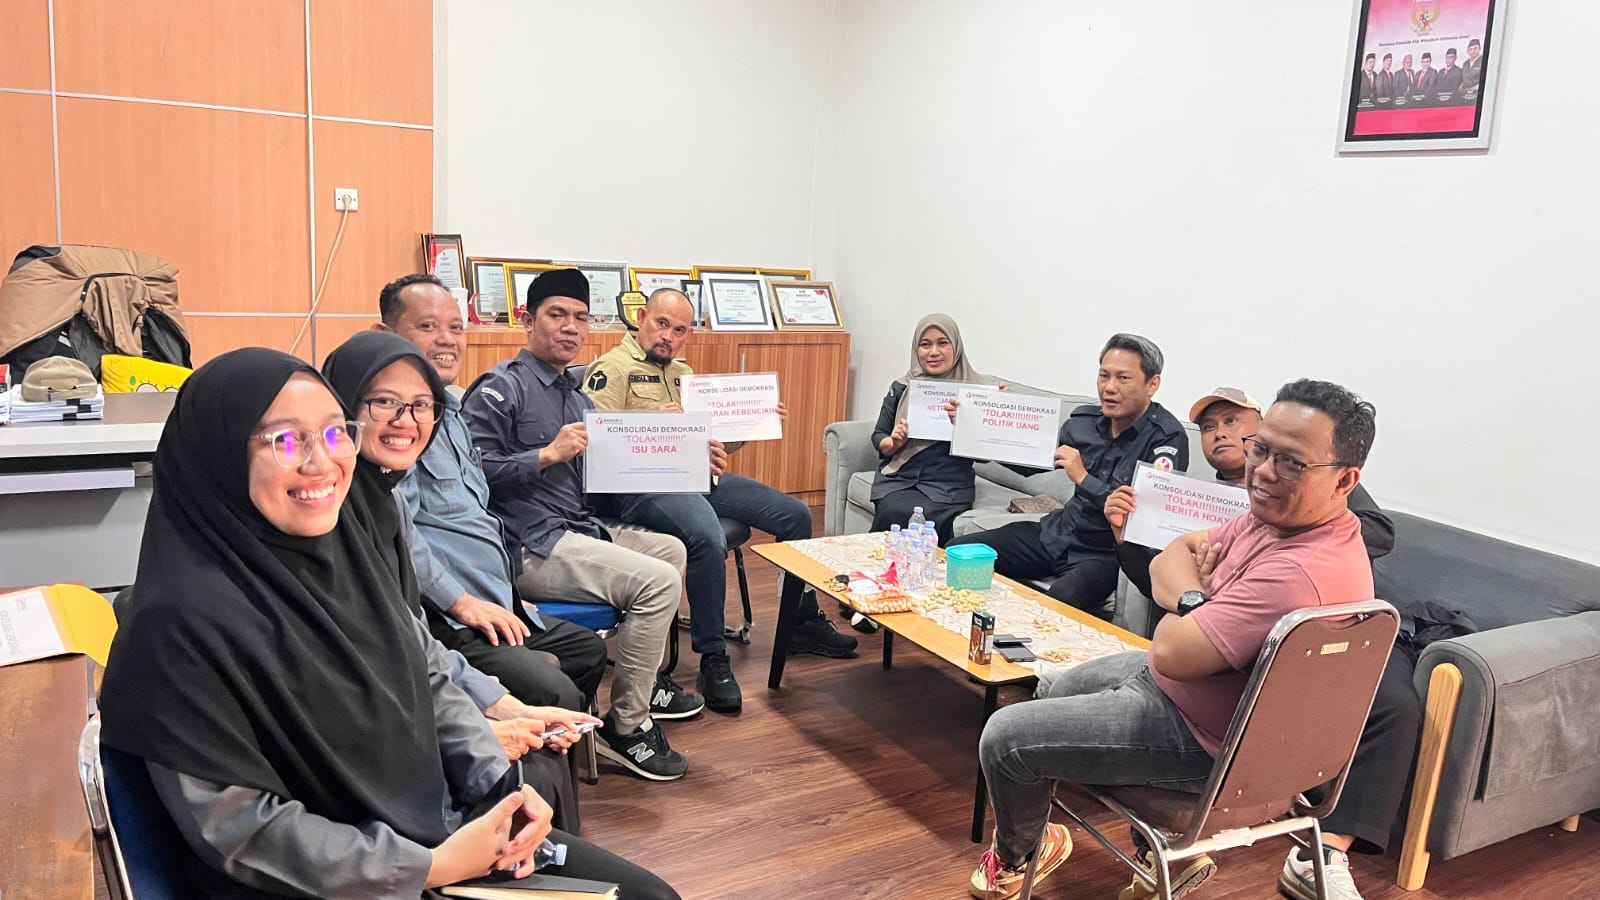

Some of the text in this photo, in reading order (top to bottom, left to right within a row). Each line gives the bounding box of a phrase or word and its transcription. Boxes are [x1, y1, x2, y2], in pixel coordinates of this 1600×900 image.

[731, 408, 775, 416] KEBENCIAN
[974, 401, 1057, 415] KONSOLIDASI DEMOKRASI
[982, 418, 1040, 431] POLITIK UANG
[631, 445, 677, 454] ISU SARA
[1153, 482, 1250, 510] KONSOLIDASI DEMOKRAS
[1164, 504, 1200, 519] BERITA
